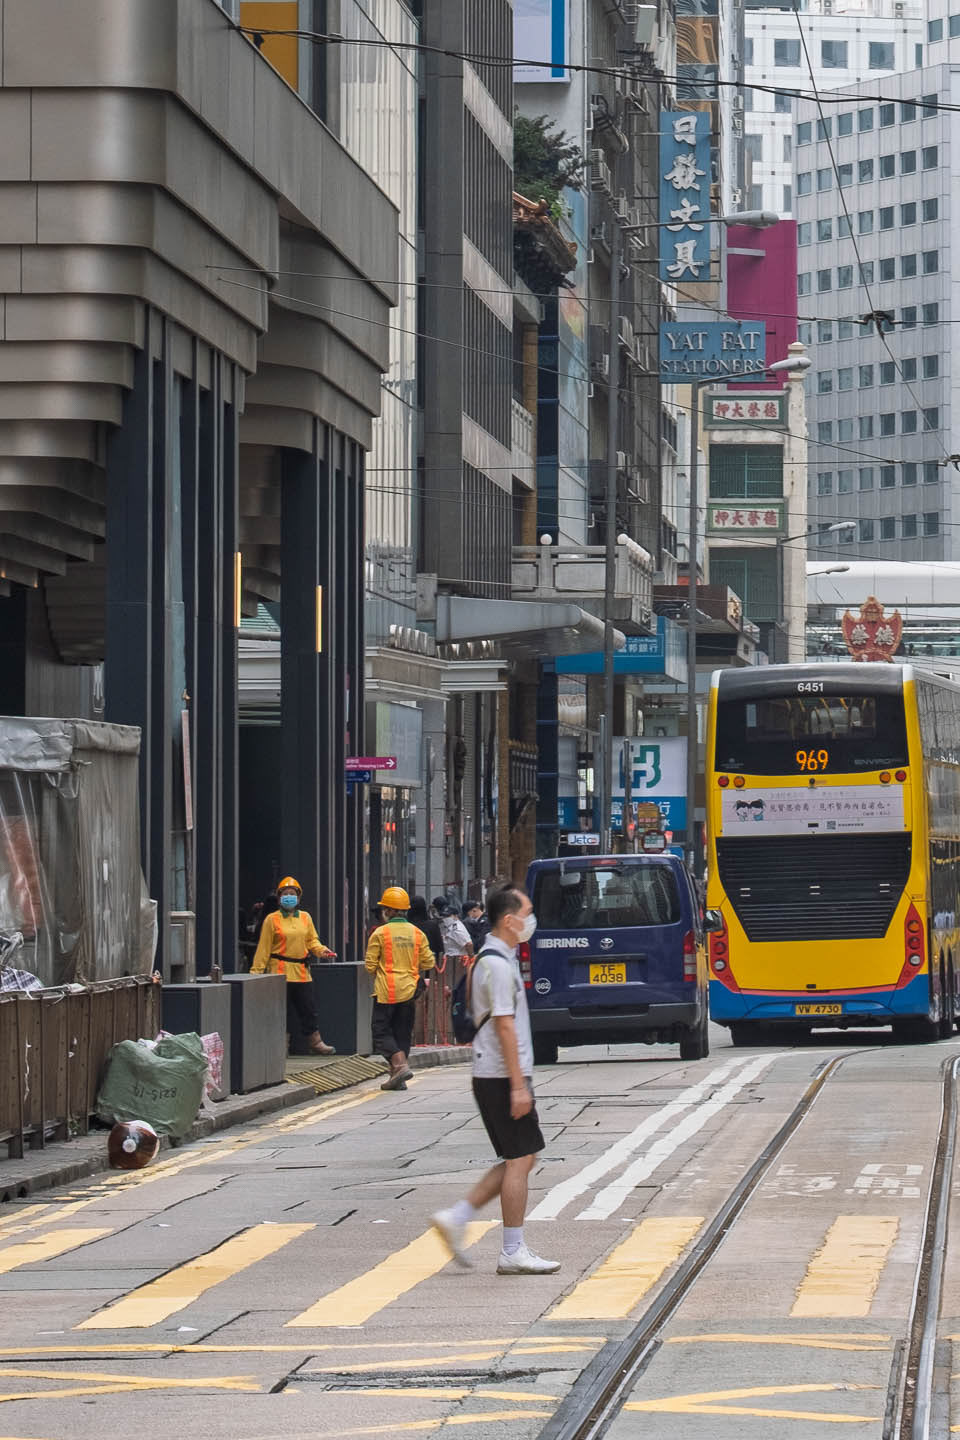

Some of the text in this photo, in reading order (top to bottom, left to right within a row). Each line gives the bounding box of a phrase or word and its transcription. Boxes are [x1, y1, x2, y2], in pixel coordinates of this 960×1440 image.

[664, 330, 761, 352] YAT FAT
[660, 359, 766, 375] STATIONERS
[797, 682, 825, 692] 6451
[796, 749, 829, 771] 969
[592, 973, 624, 983] 4038
[815, 1005, 840, 1013] 4730
